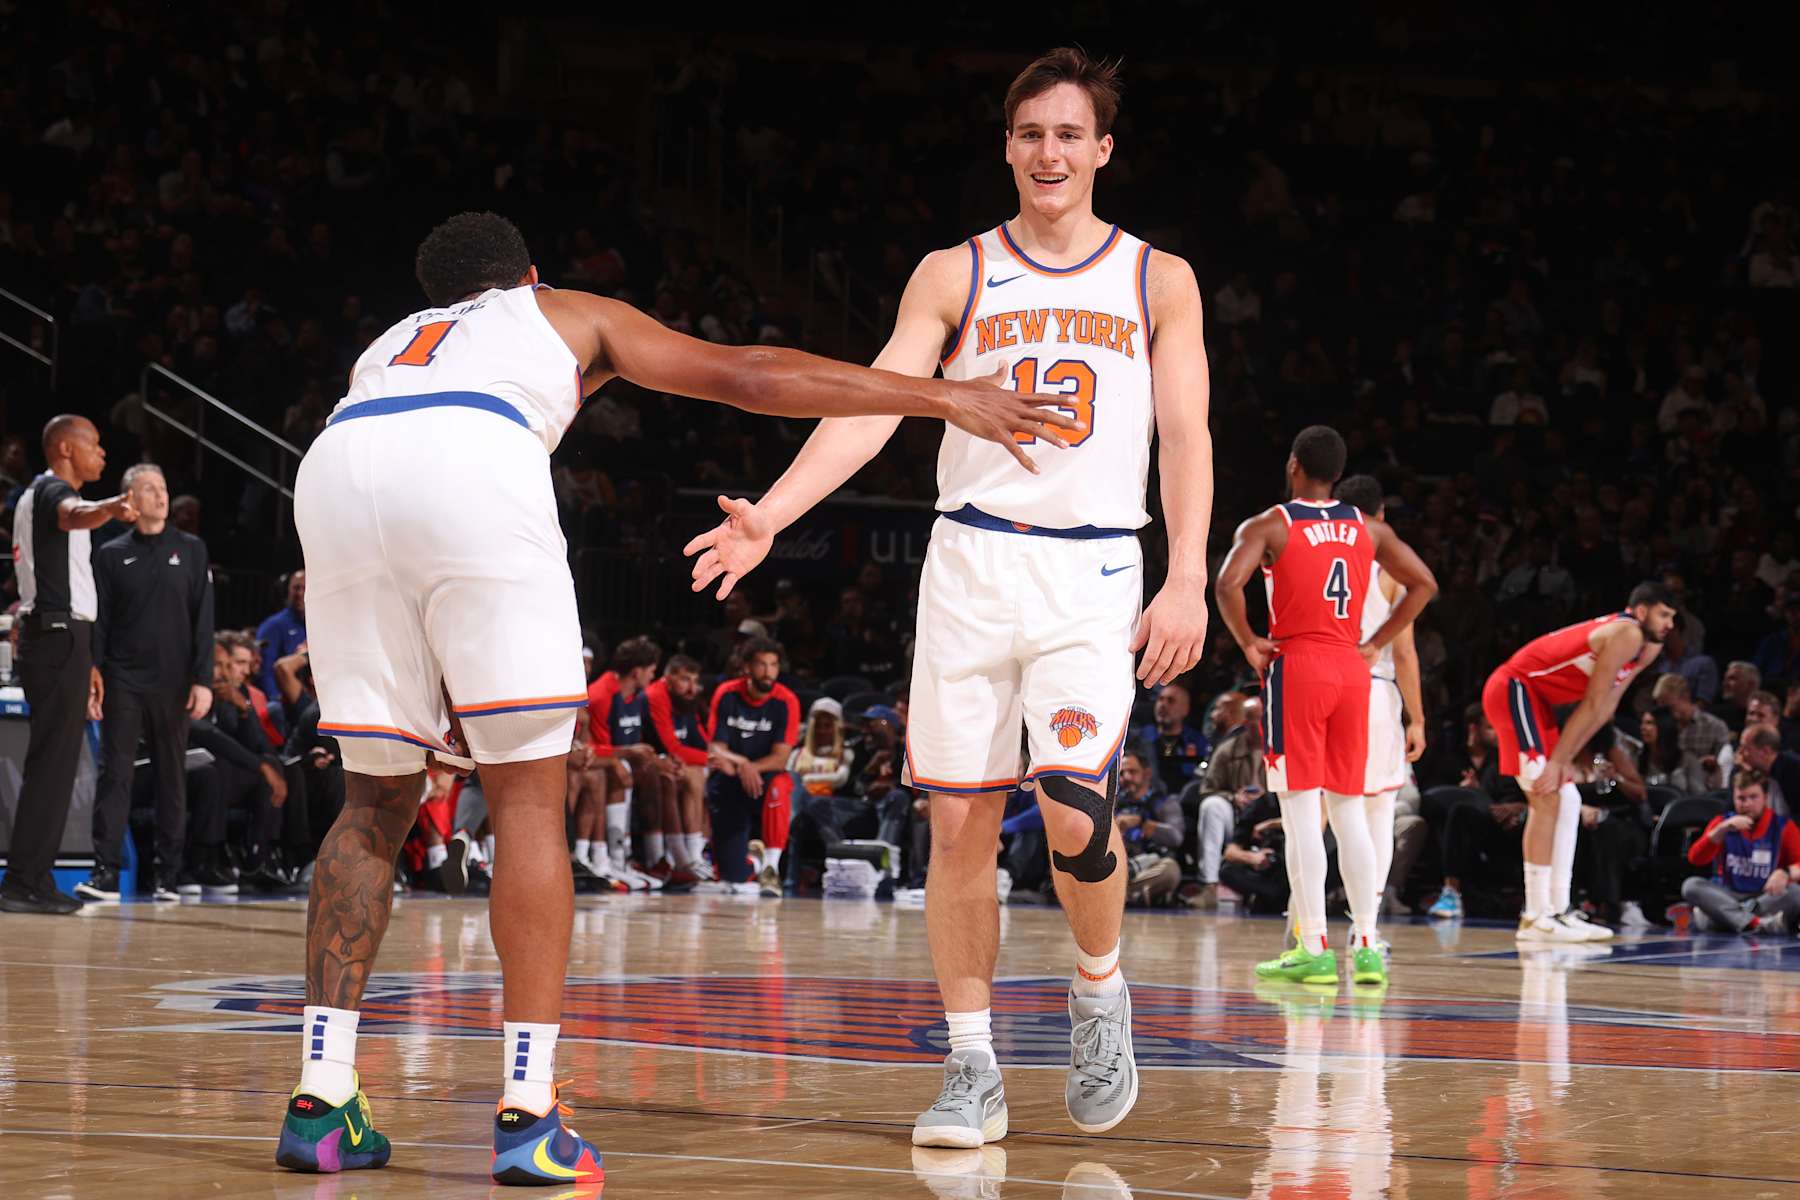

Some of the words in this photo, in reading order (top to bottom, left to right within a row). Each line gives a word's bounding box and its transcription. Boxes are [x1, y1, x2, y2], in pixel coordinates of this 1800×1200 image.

[387, 320, 459, 367] 1
[976, 309, 1050, 355] NEW
[1053, 308, 1138, 359] YORK
[1012, 357, 1097, 448] 13
[870, 530, 930, 563] UL
[1303, 522, 1358, 547] BUTLER
[1323, 558, 1352, 618] 4
[1049, 708, 1098, 738] KNICKS
